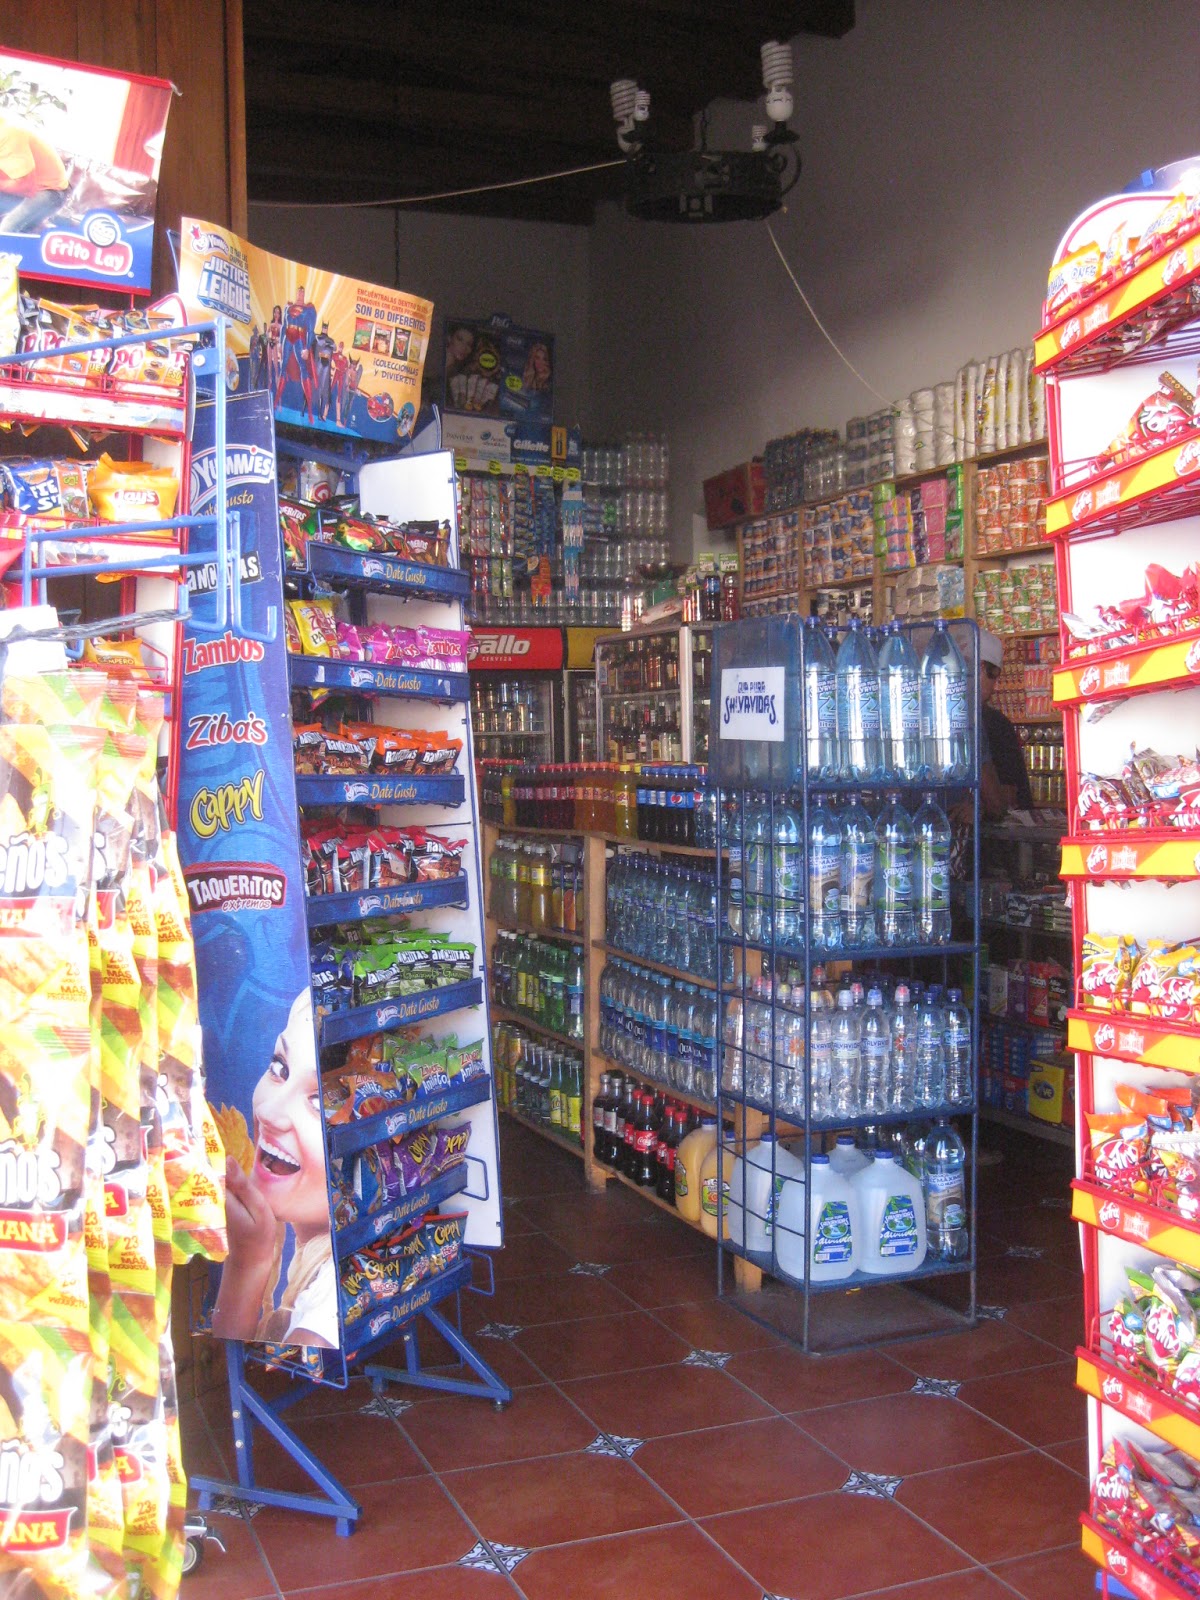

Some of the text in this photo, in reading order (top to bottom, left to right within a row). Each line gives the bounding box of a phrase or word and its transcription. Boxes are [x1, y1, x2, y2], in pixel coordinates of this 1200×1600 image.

[50, 238, 124, 271] Frito Lay
[204, 256, 248, 288] JUSTICE
[199, 272, 251, 317] LEAGUE
[355, 303, 426, 332] SON 80 DIFERENTES
[513, 440, 549, 452] Gillette
[385, 563, 404, 581] Date
[405, 565, 426, 586] Gusto
[183, 631, 265, 675] Zambos
[375, 673, 421, 690] Date Gusto
[186, 711, 268, 749] Ziba's
[371, 783, 417, 799] Date Gusto
[190, 770, 264, 838] Cappy
[222, 897, 272, 913] extremos
[400, 995, 439, 1018] Date Gusto
[408, 1100, 448, 1124] Date Gusto
[393, 1203, 410, 1221] Date
[434, 1220, 461, 1247] Cappy
[364, 1260, 400, 1281] Cappy
[392, 1289, 431, 1321] Date Gusto
